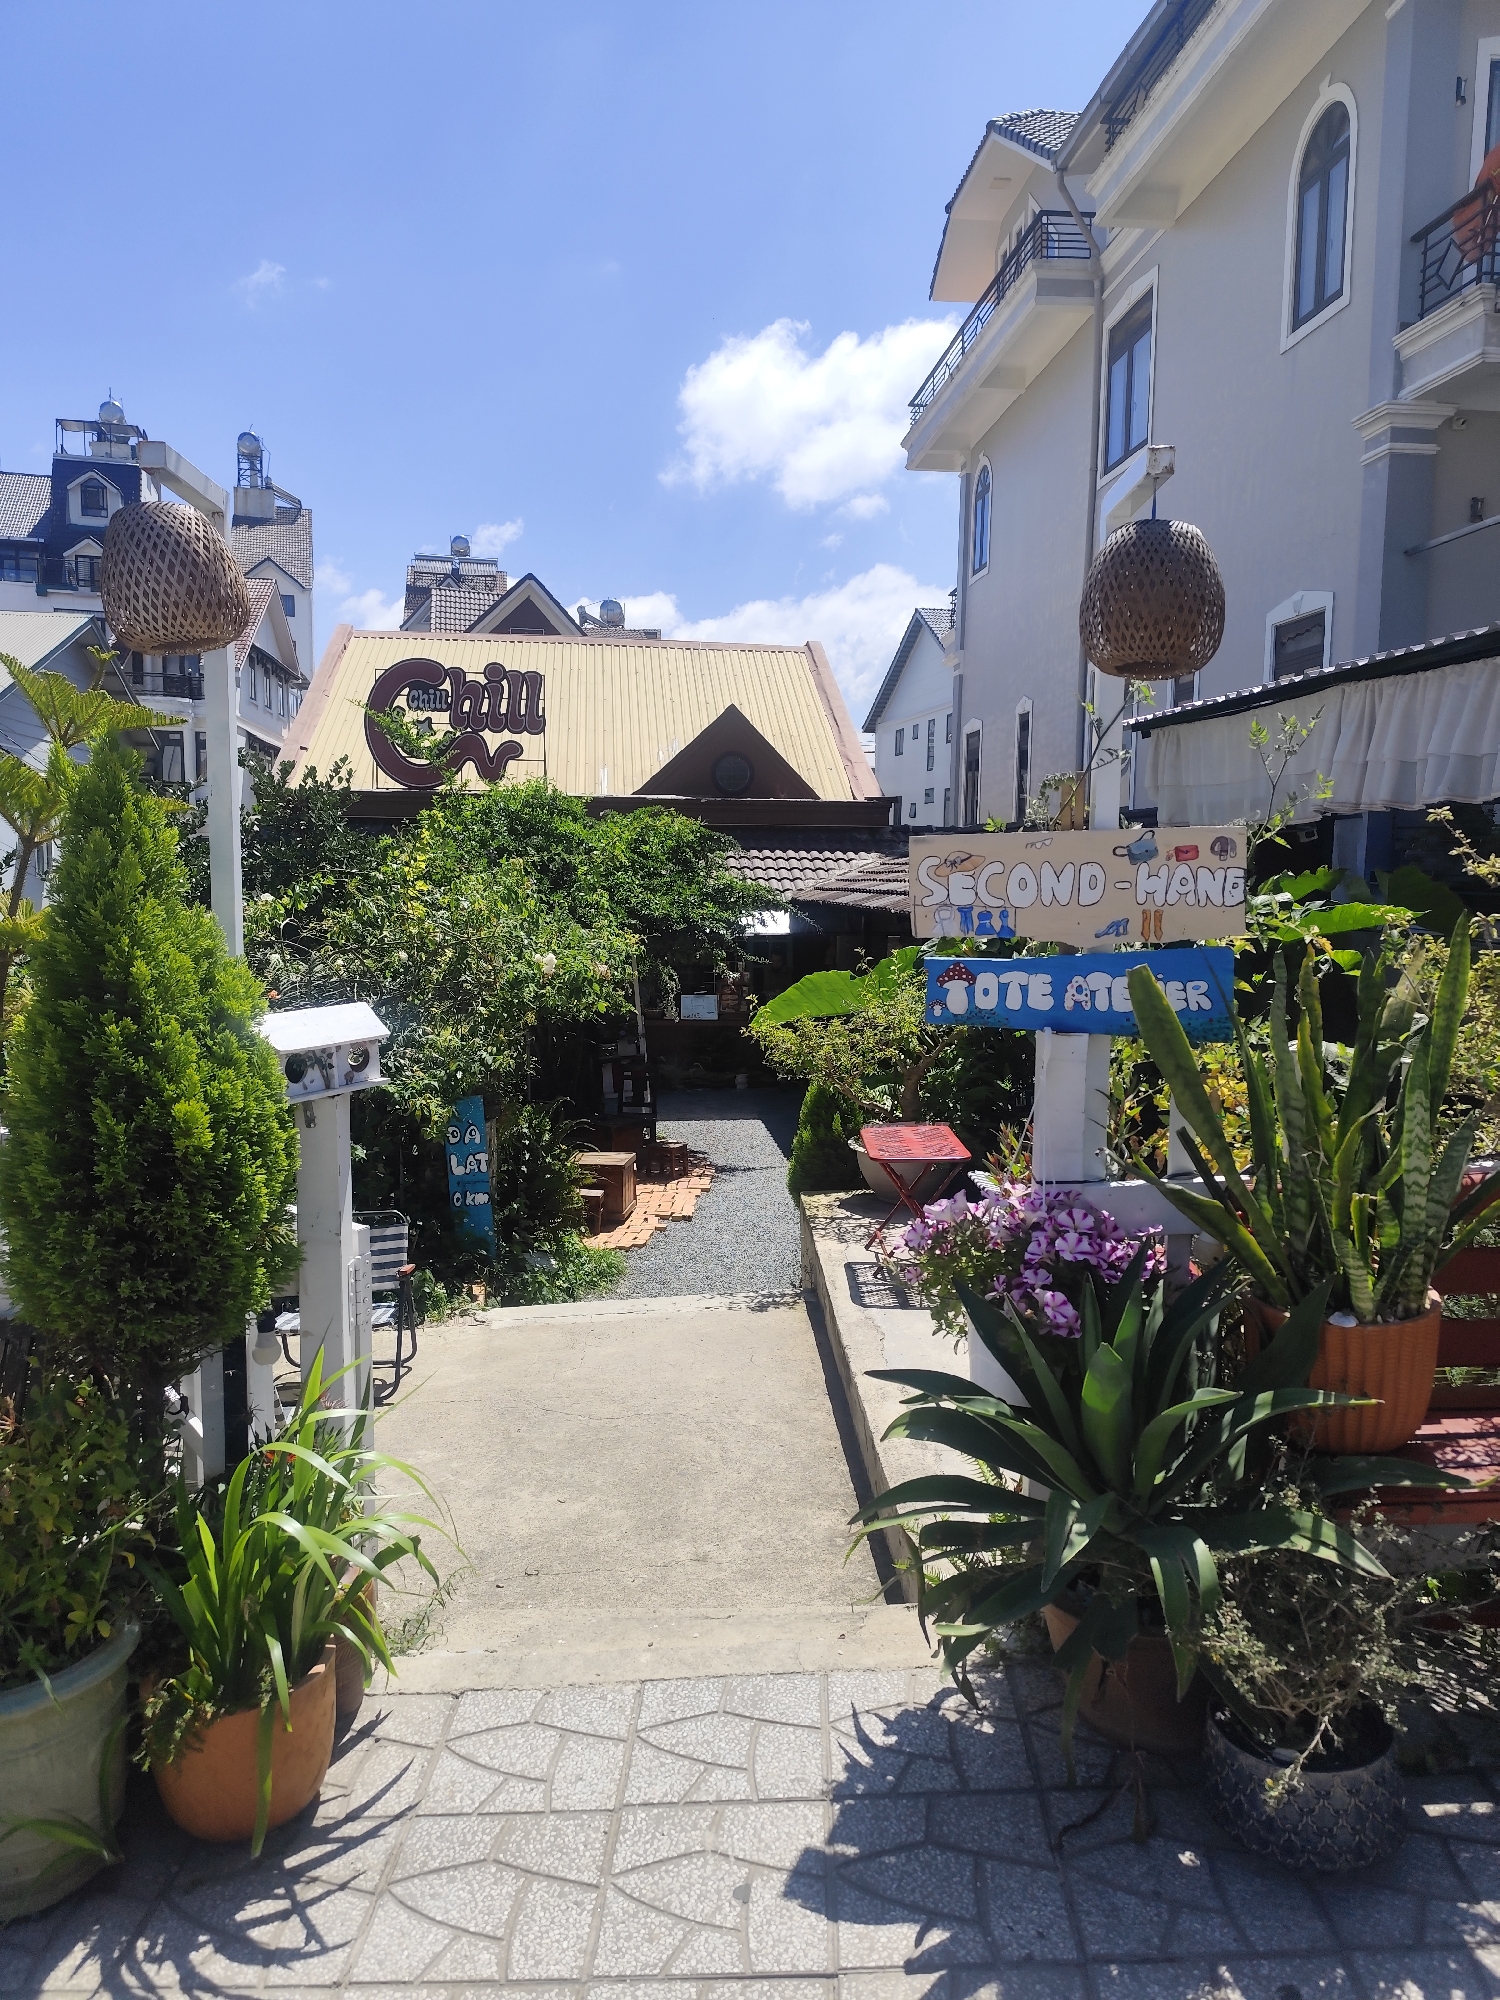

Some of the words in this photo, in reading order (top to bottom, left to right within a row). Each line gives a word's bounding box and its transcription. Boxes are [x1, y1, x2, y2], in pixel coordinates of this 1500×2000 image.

[364, 657, 546, 790] Chill
[408, 688, 449, 709] Chill
[936, 961, 1054, 1015] TOTE
